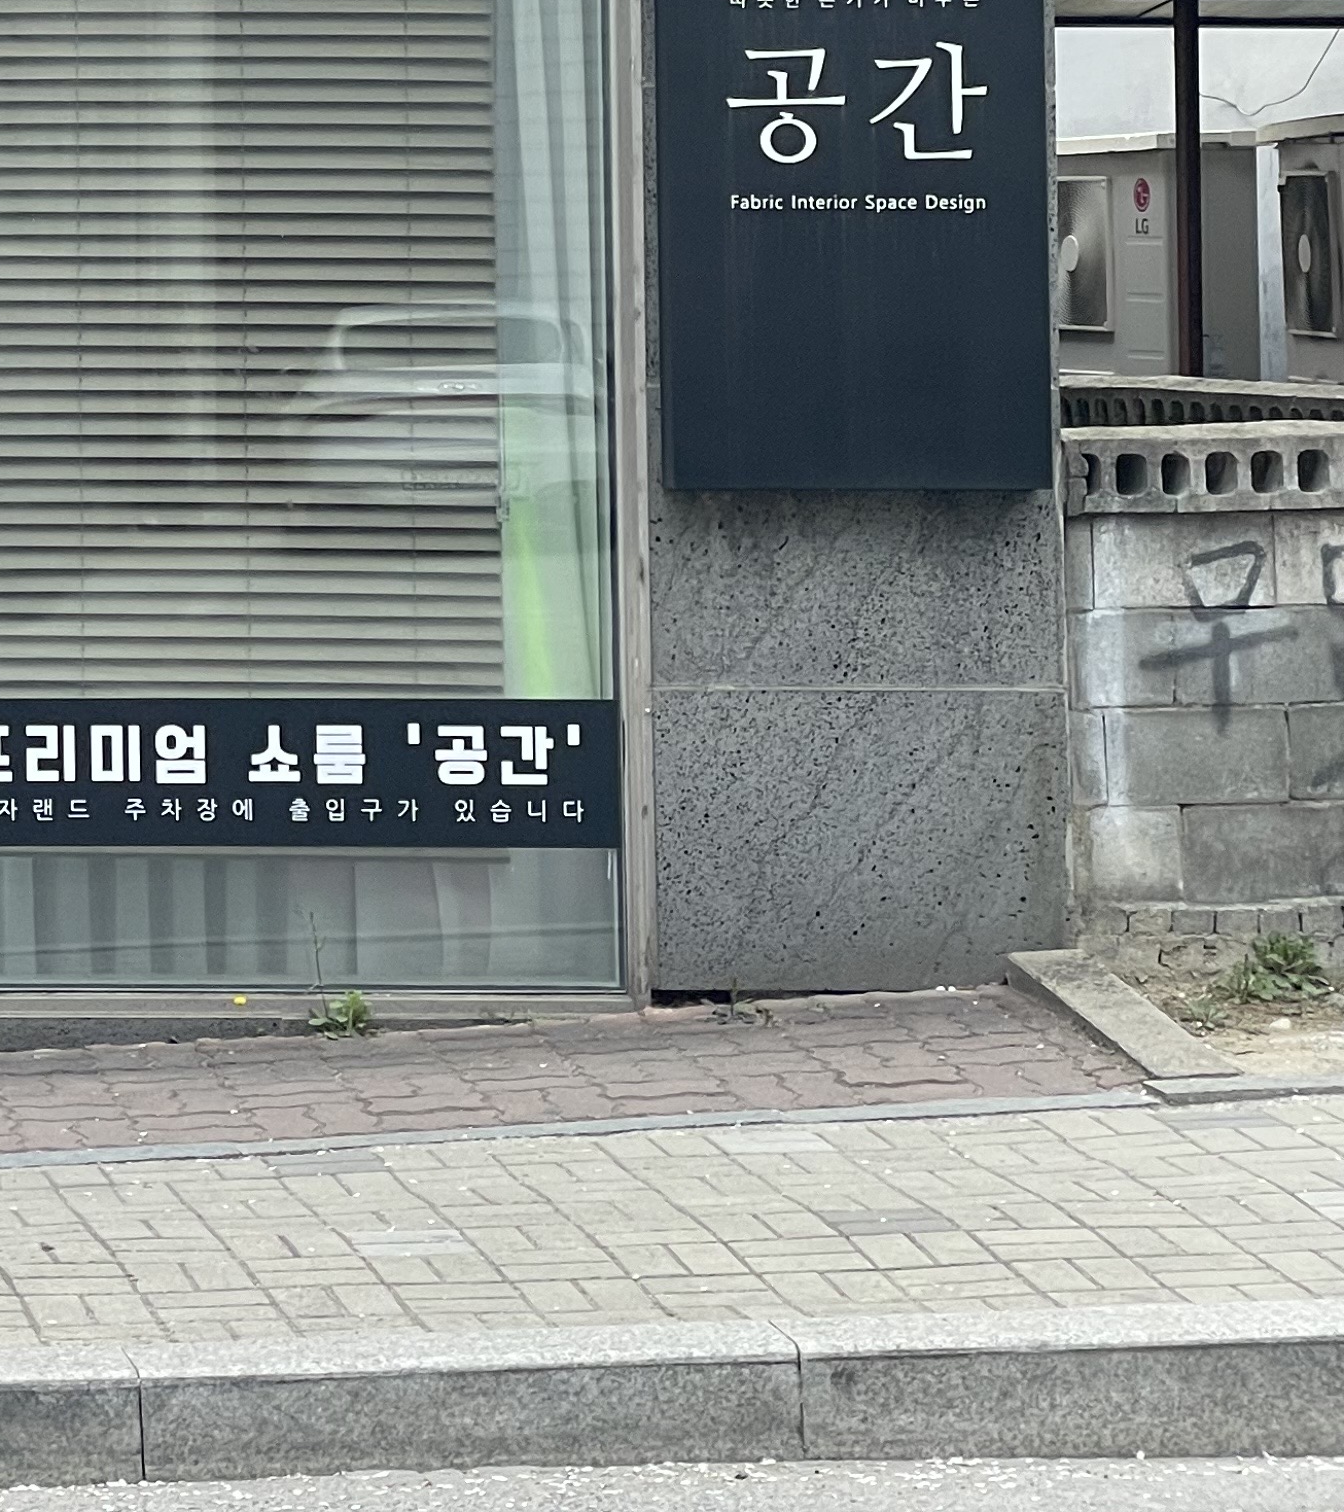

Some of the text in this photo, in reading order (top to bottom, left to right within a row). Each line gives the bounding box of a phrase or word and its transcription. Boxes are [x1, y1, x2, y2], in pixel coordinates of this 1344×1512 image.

[725, 41, 988, 164] 공간
[730, 193, 986, 214] Fabric Interior Space Design
[1135, 217, 1150, 235] LG
[248, 724, 366, 785] 쇼룸
[124, 798, 253, 822] 주차장에
[288, 798, 419, 822] 출입구가
[454, 799, 585, 823] 있습니다
